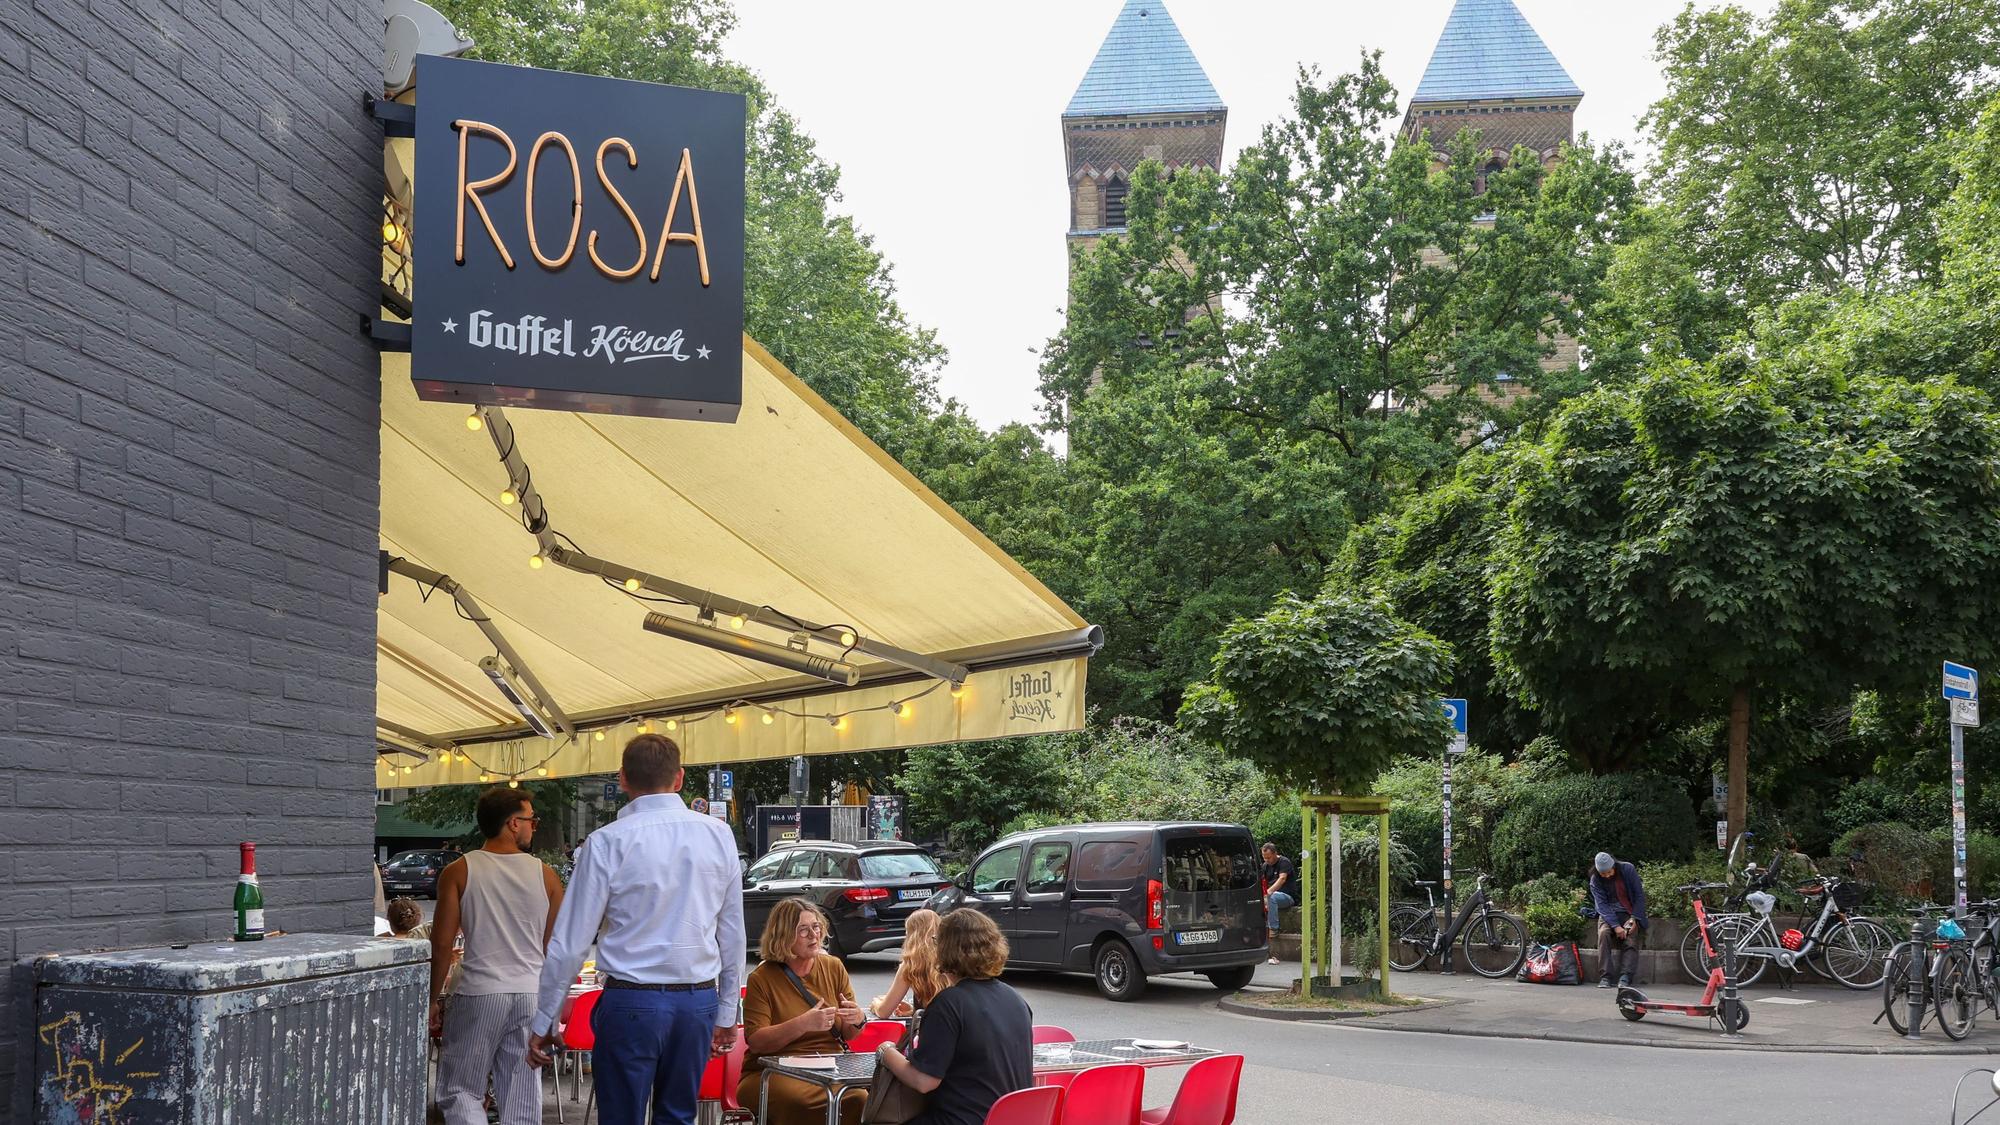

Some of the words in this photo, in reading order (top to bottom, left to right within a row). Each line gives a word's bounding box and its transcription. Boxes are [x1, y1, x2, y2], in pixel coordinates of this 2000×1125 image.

[454, 119, 711, 287] ROSA
[468, 309, 577, 357] Gaffel
[583, 323, 691, 364] Kölsch
[1190, 932, 1200, 941] GG
[1200, 931, 1217, 941] 1968
